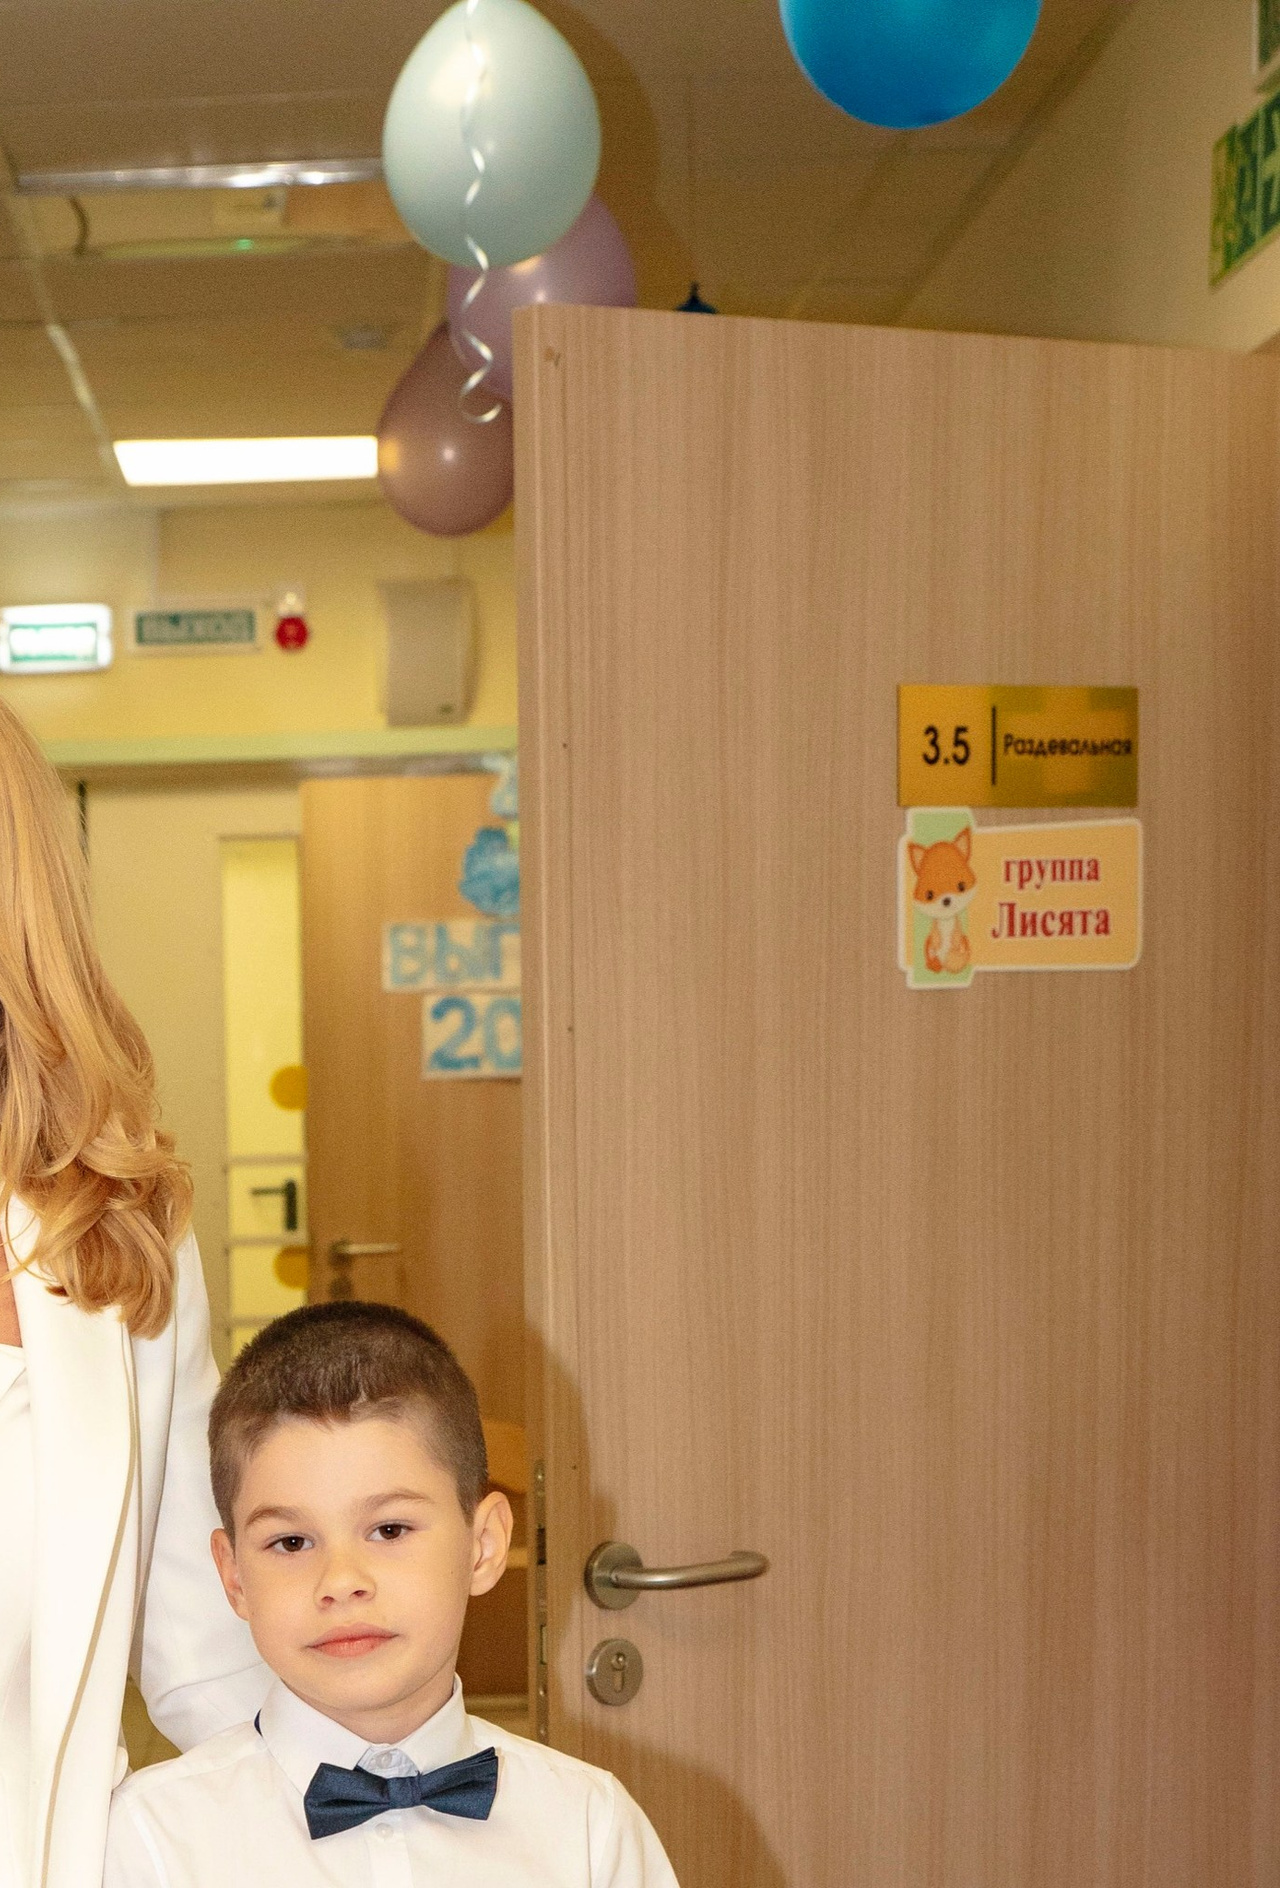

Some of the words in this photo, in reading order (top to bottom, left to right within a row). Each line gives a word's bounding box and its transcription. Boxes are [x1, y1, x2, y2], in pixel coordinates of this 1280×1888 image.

[922, 725, 970, 765] 3.5
[1003, 733, 1132, 757] Раздевальная
[1003, 857, 1100, 890] группа
[992, 902, 1111, 938] Лисята
